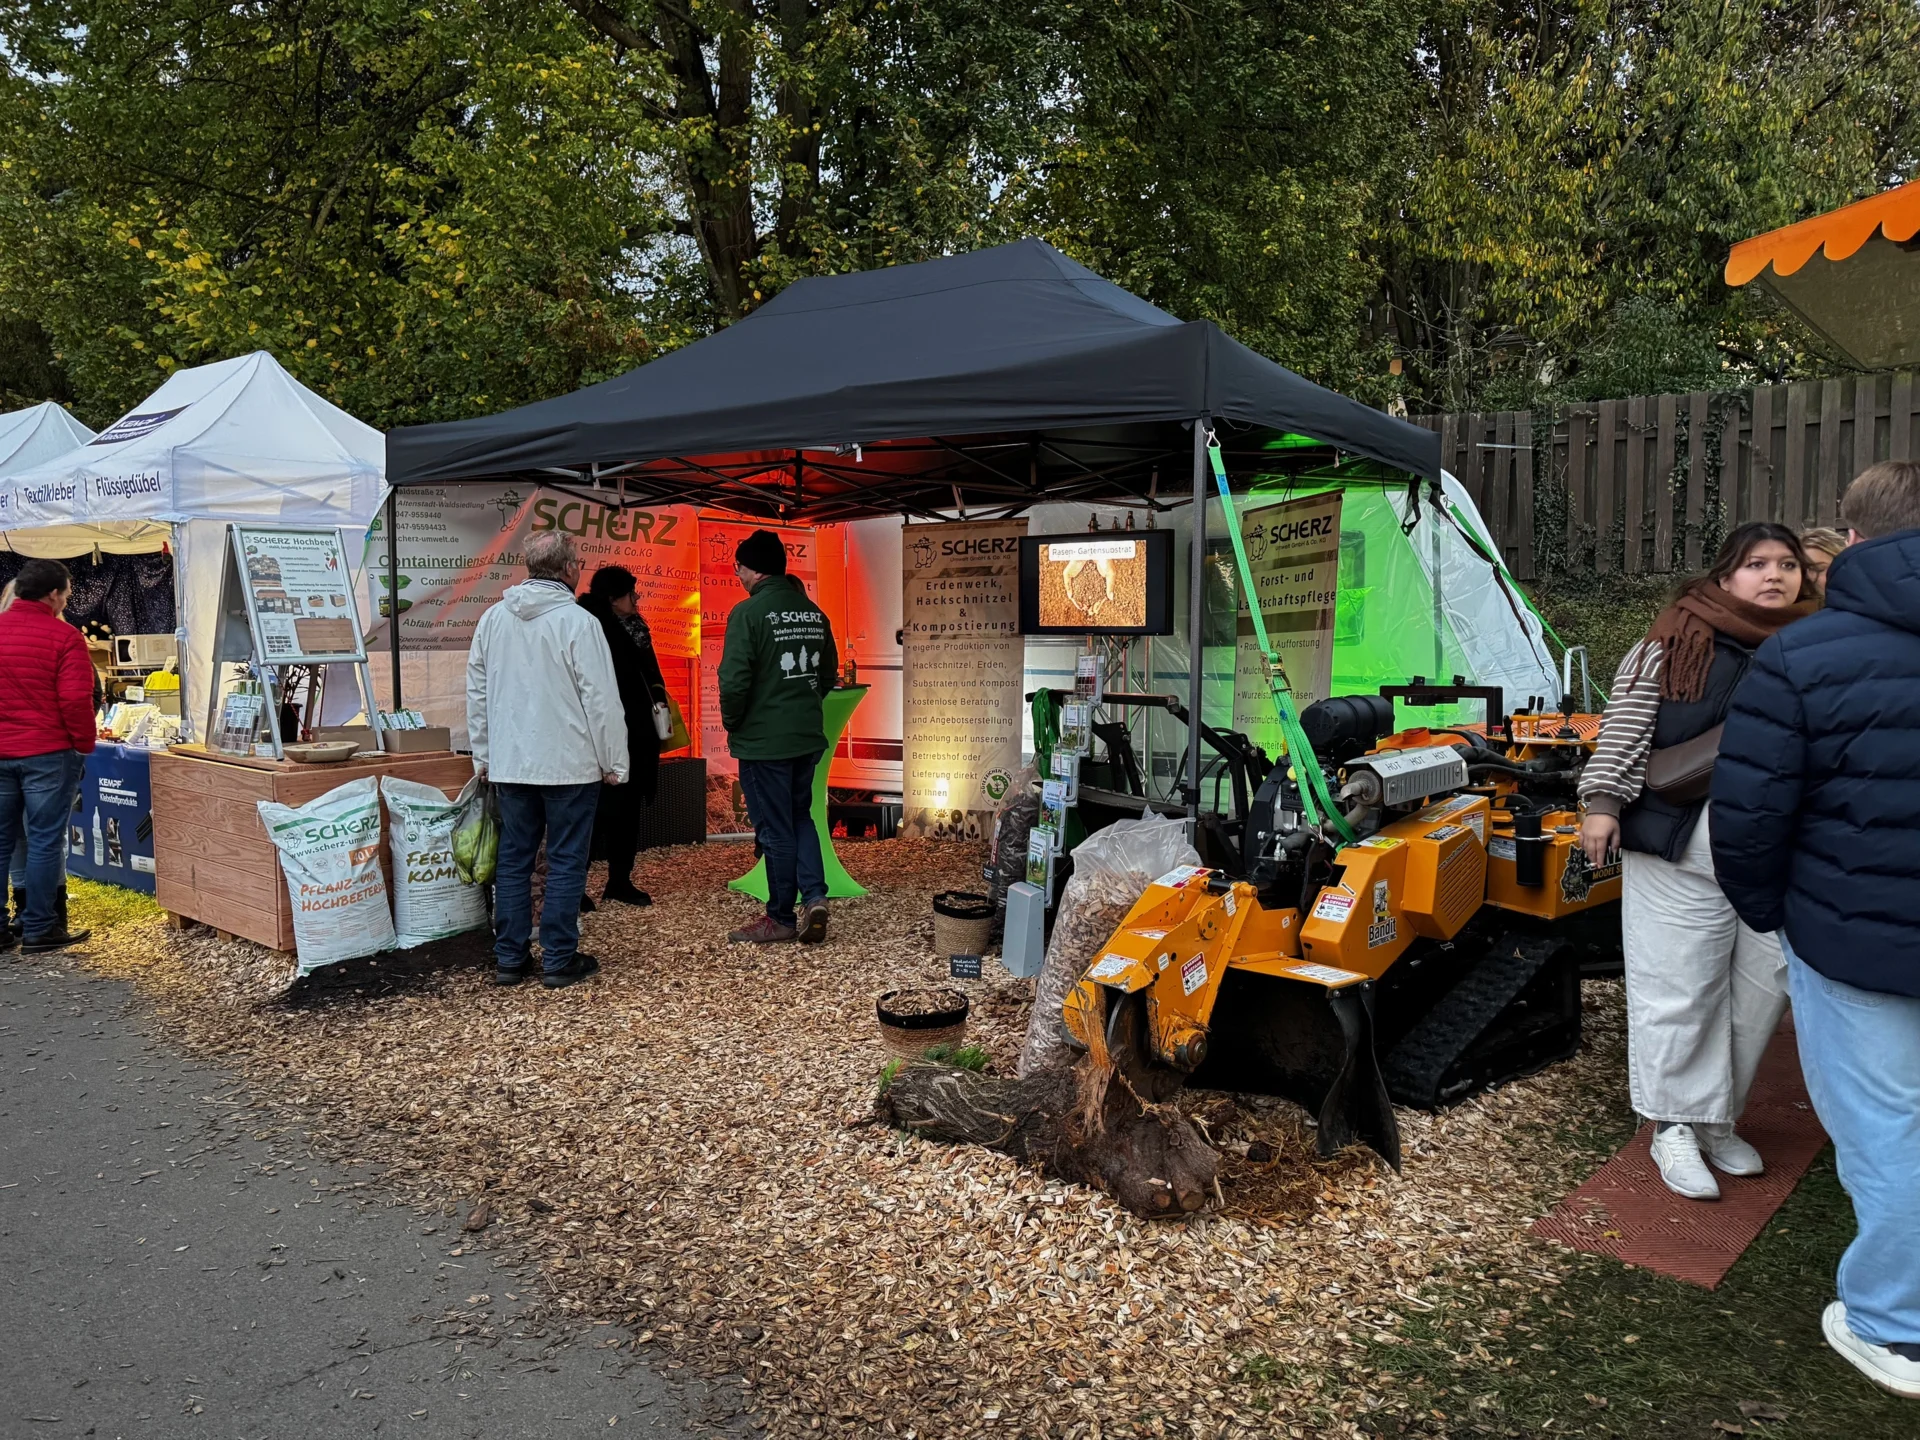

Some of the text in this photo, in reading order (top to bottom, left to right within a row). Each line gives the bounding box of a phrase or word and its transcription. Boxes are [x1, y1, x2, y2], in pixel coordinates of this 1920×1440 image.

[24, 482, 76, 504] Textilkleber
[96, 471, 161, 499] Flüssigdübel
[396, 488, 434, 496] aldstraße
[397, 500, 485, 510] Altenstadt-Waldsiedlung
[395, 511, 442, 519] 047-9559440
[396, 523, 447, 531] 047-95594433
[531, 498, 678, 547] SCHERZ
[1270, 515, 1333, 545] SCHERZ
[254, 536, 334, 546] SCHERZ Hochbeet
[942, 537, 1018, 556] SCHERZ
[581, 542, 653, 557] GmbH & Co.KG
[1052, 548, 1076, 556] Rasen-
[654, 564, 662, 576] &
[420, 575, 462, 586] Container
[489, 572, 500, 581] 38
[1260, 568, 1314, 587] Forst- und
[926, 578, 1003, 591] Erdenwerk,
[647, 591, 680, 601] Kompost
[916, 592, 1013, 606] Hackschnitzel
[1238, 591, 1336, 611] Ladschaftspflege
[781, 611, 822, 623] SCHERZ
[959, 608, 967, 618] &
[402, 618, 434, 629] Abfälle
[912, 620, 1016, 634] Kompostierung
[773, 628, 793, 636] Telefon
[912, 642, 1010, 653] eigene Produktion von
[1276, 639, 1321, 650] Aufforstung
[912, 660, 1007, 670] Hackschnitzel, Erden,
[912, 679, 1019, 689] Substraten und Kompost
[912, 697, 1000, 708] kostenlose Beratung
[912, 716, 1013, 727] und Angebotserstellung
[912, 734, 951, 744] Abholung
[912, 752, 981, 761] Betriebshof oder
[1385, 751, 1448, 771] HOT HOT HOT
[912, 770, 978, 780] Lieferung direkt
[99, 778, 122, 788] KEMPF
[924, 789, 948, 797] Ihnen
[99, 793, 138, 807] Klebstoffprodukte
[305, 815, 380, 844] SCHERZ
[1592, 867, 1616, 881] MODEL
[301, 870, 377, 897] PFLANZ- UND
[1368, 918, 1396, 941] Bandit
